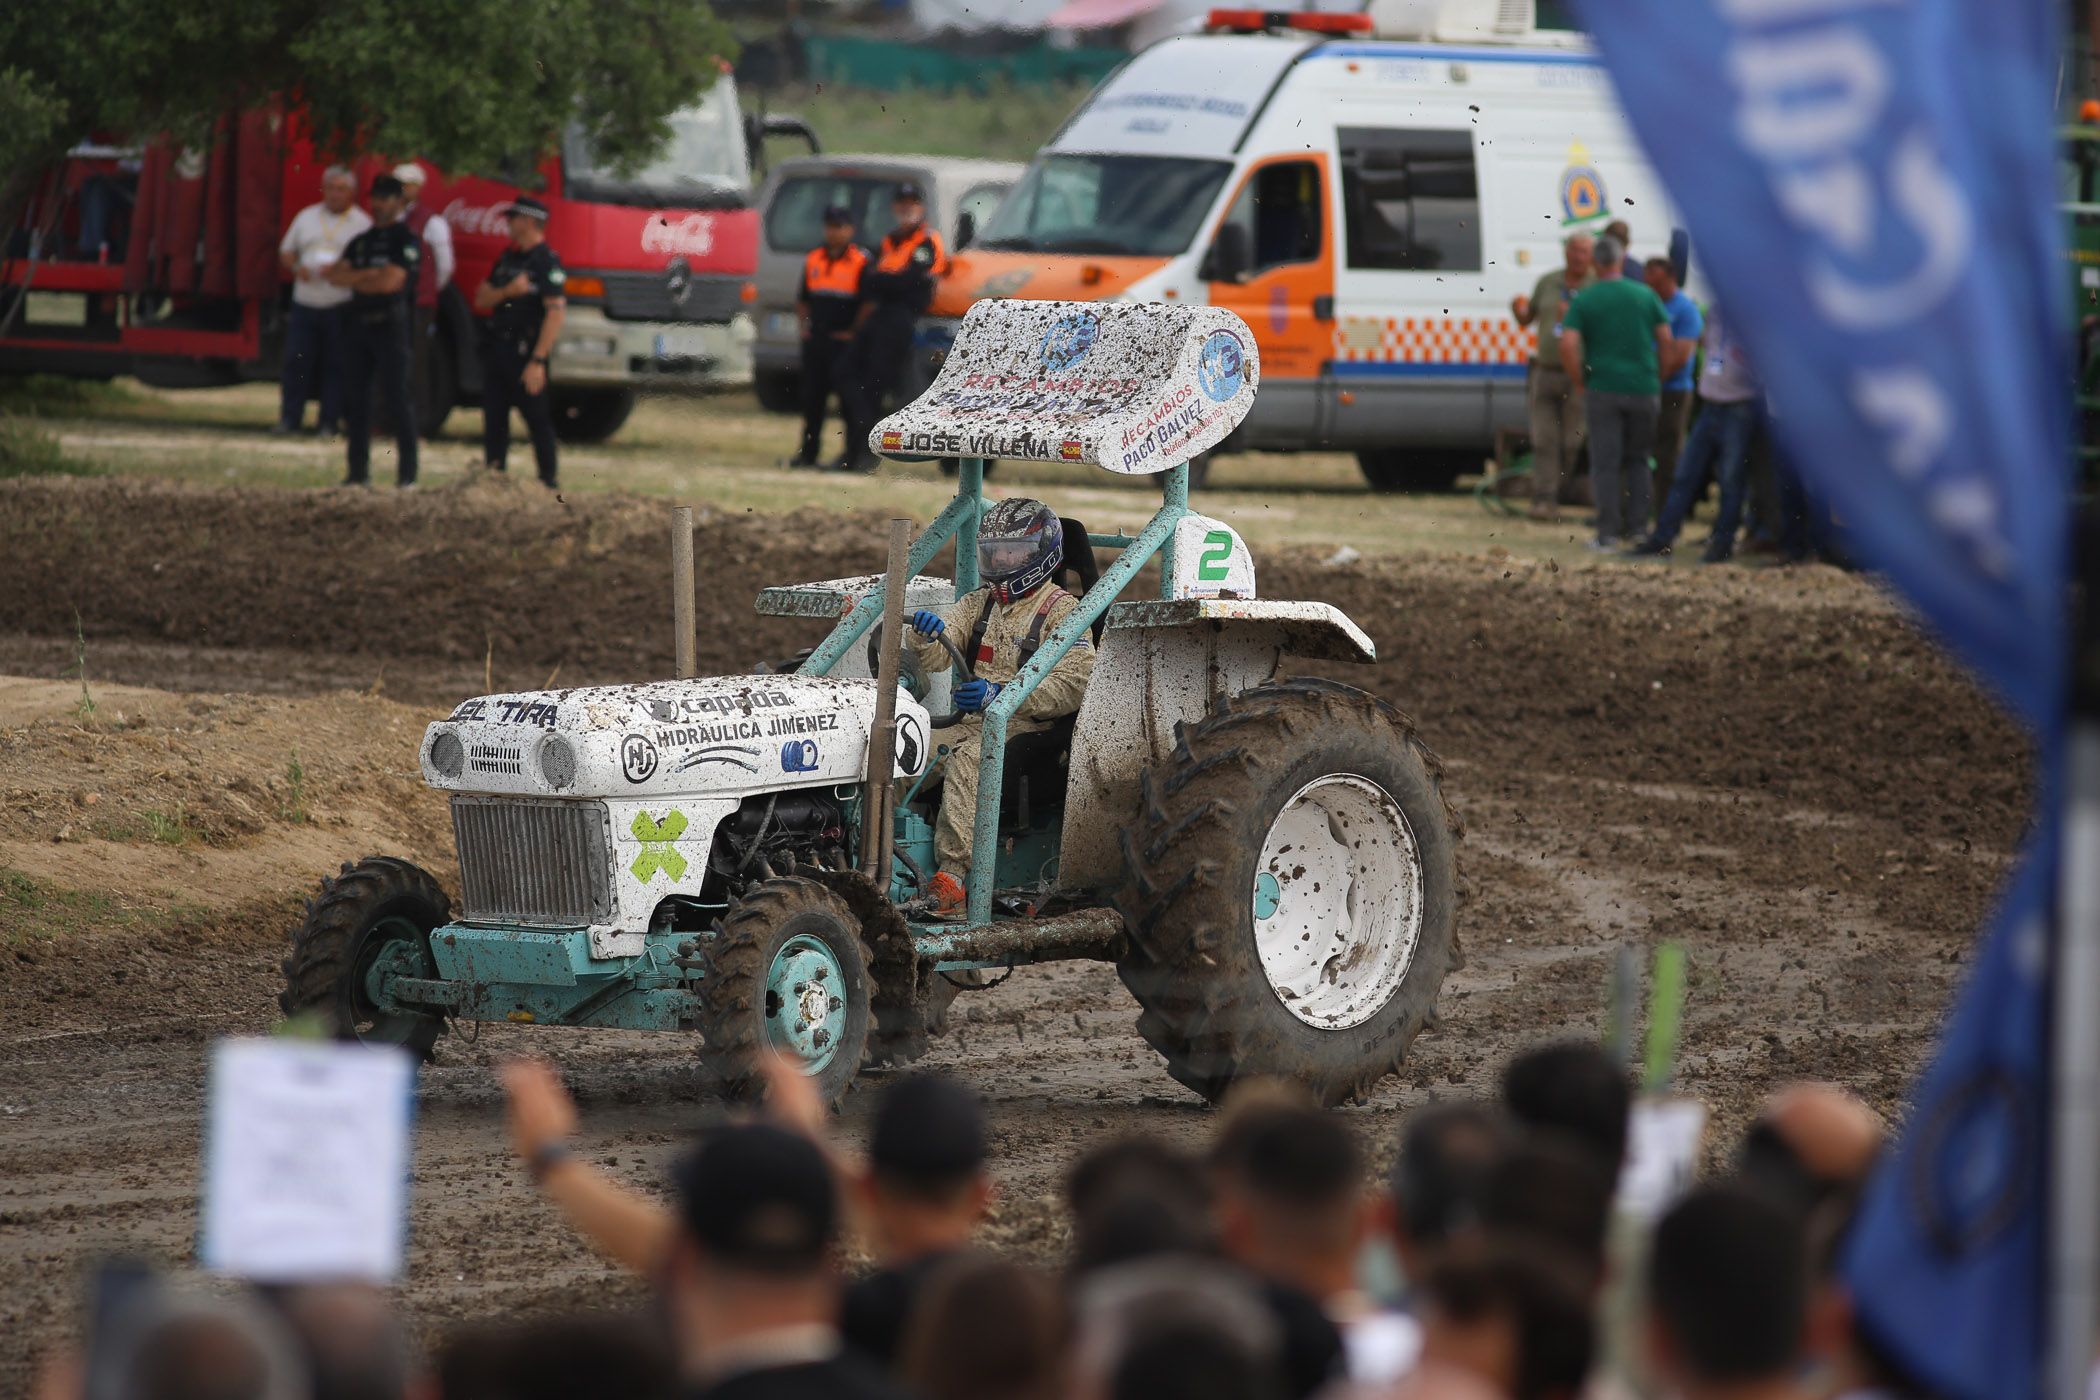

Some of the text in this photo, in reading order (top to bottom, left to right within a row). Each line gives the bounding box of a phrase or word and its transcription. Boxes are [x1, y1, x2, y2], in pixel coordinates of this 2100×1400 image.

[961, 373, 1136, 394] RECAMBIOS
[1121, 384, 1193, 449] RECAMBIOS
[1122, 398, 1204, 472] PACO GALVEZ
[902, 433, 1050, 458] JOSE VILLENA
[1198, 530, 1232, 580] 2
[457, 700, 558, 727] EL TIRA
